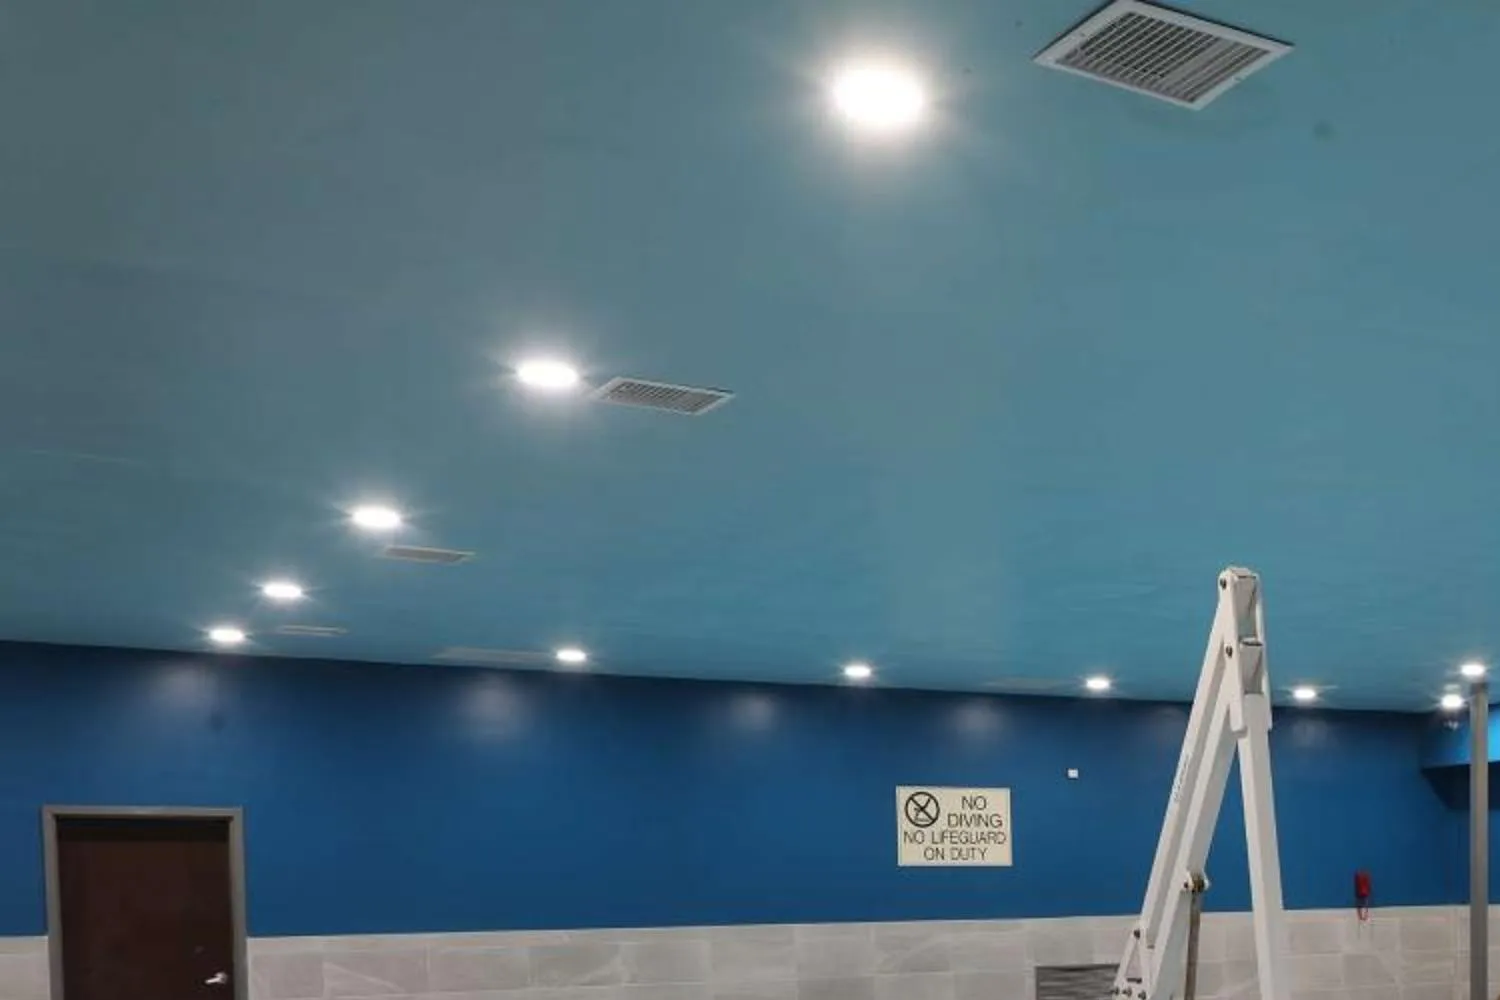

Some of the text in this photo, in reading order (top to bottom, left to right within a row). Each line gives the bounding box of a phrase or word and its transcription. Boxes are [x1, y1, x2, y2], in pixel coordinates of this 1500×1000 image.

[961, 795, 987, 811] NO
[947, 812, 1003, 828] DIVING
[904, 830, 1007, 845] NO LIFEGUARD
[923, 847, 988, 861] ON DUTY
